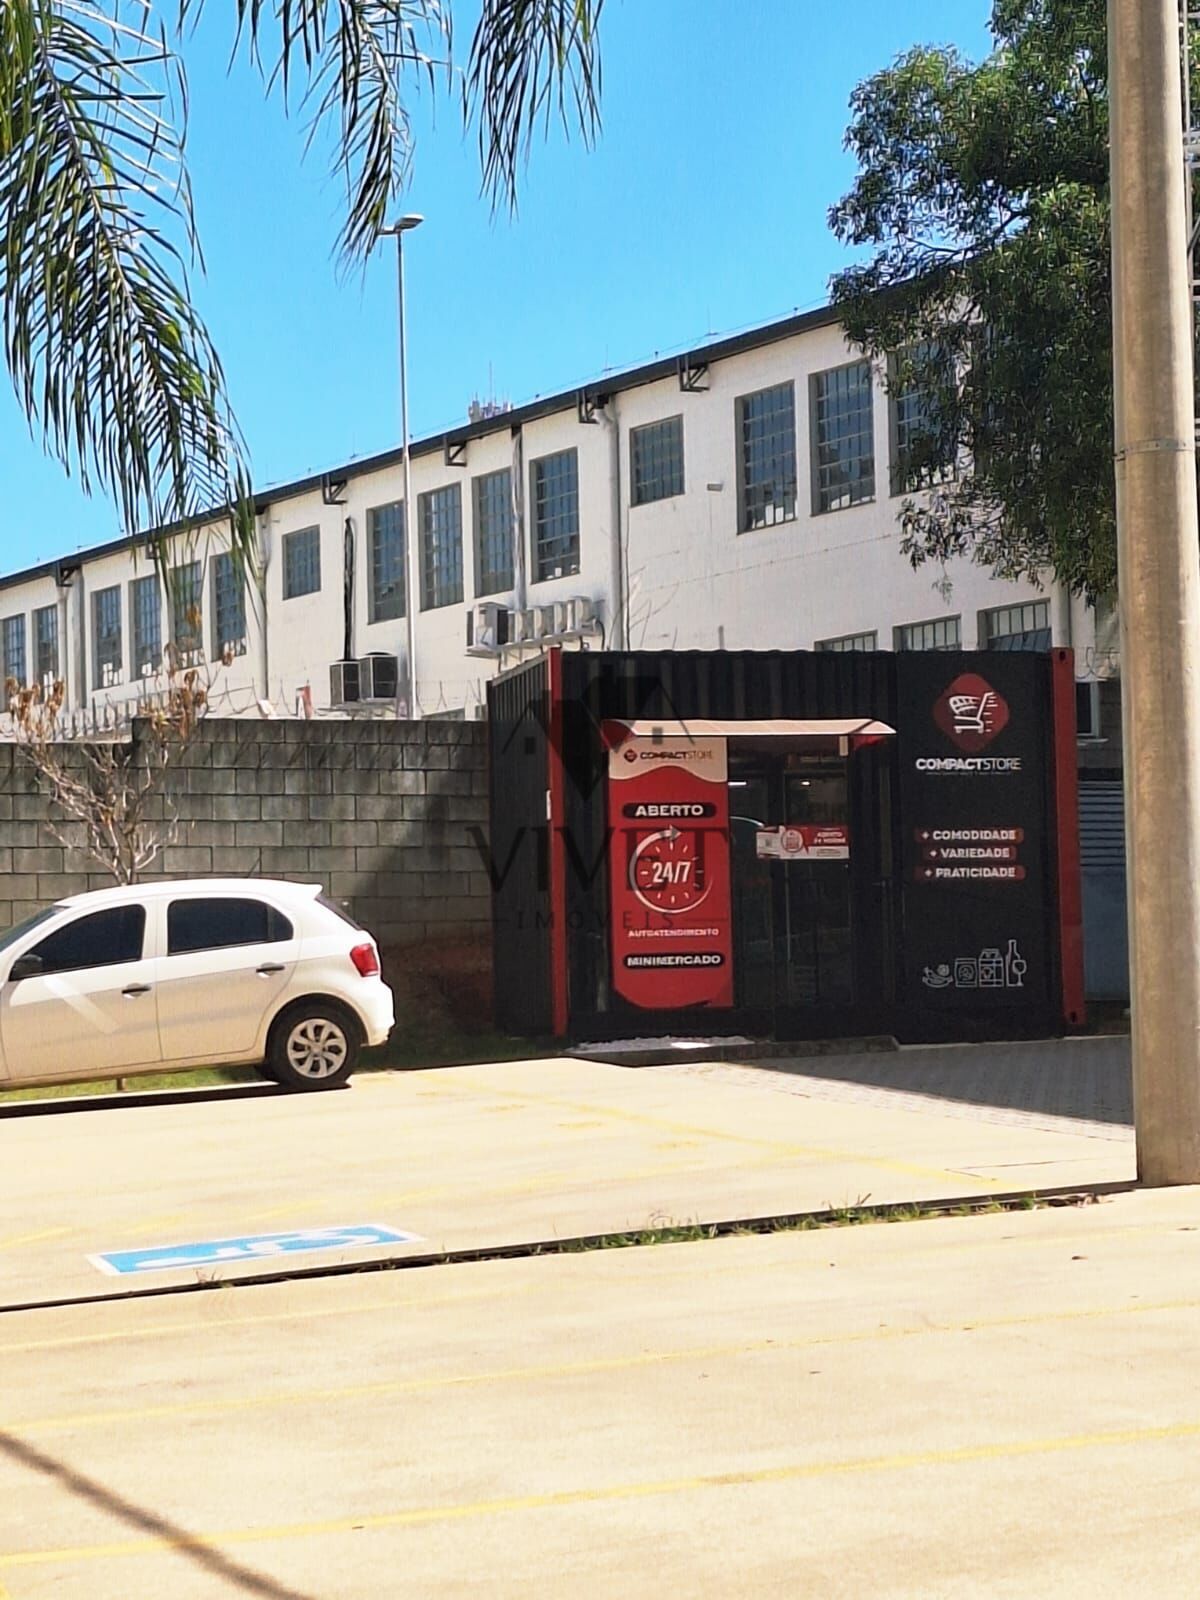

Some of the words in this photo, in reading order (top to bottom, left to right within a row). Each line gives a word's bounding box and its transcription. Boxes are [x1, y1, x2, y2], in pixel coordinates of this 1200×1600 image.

[915, 757, 1022, 771] COMPACTSTORE
[635, 804, 704, 817] ABERTO
[932, 830, 1017, 841] COMODIDADE
[940, 848, 1010, 858] VARIEDADE
[651, 861, 692, 884] 24/7
[935, 867, 1016, 878] PRATICIDADE
[627, 955, 721, 967] MINIMERCADO
